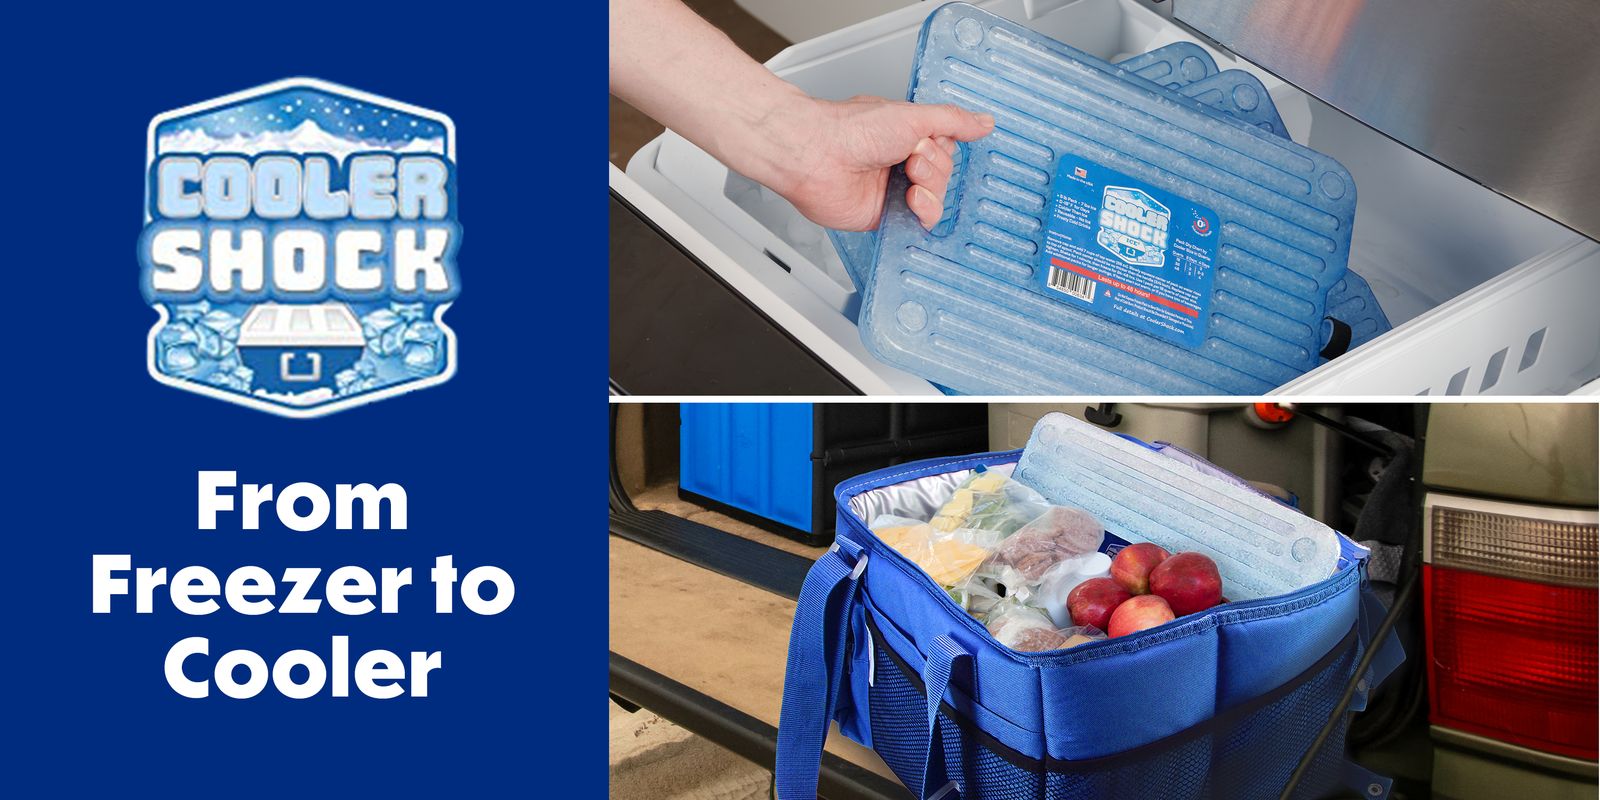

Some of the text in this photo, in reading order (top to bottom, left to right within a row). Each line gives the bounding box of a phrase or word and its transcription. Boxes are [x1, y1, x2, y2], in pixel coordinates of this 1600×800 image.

[1103, 194, 1168, 231] COOLER
[1100, 209, 1167, 248] SHOCK
[1098, 274, 1112, 284] Lasts
[1113, 303, 1122, 311] Full
[1123, 307, 1138, 317] details
